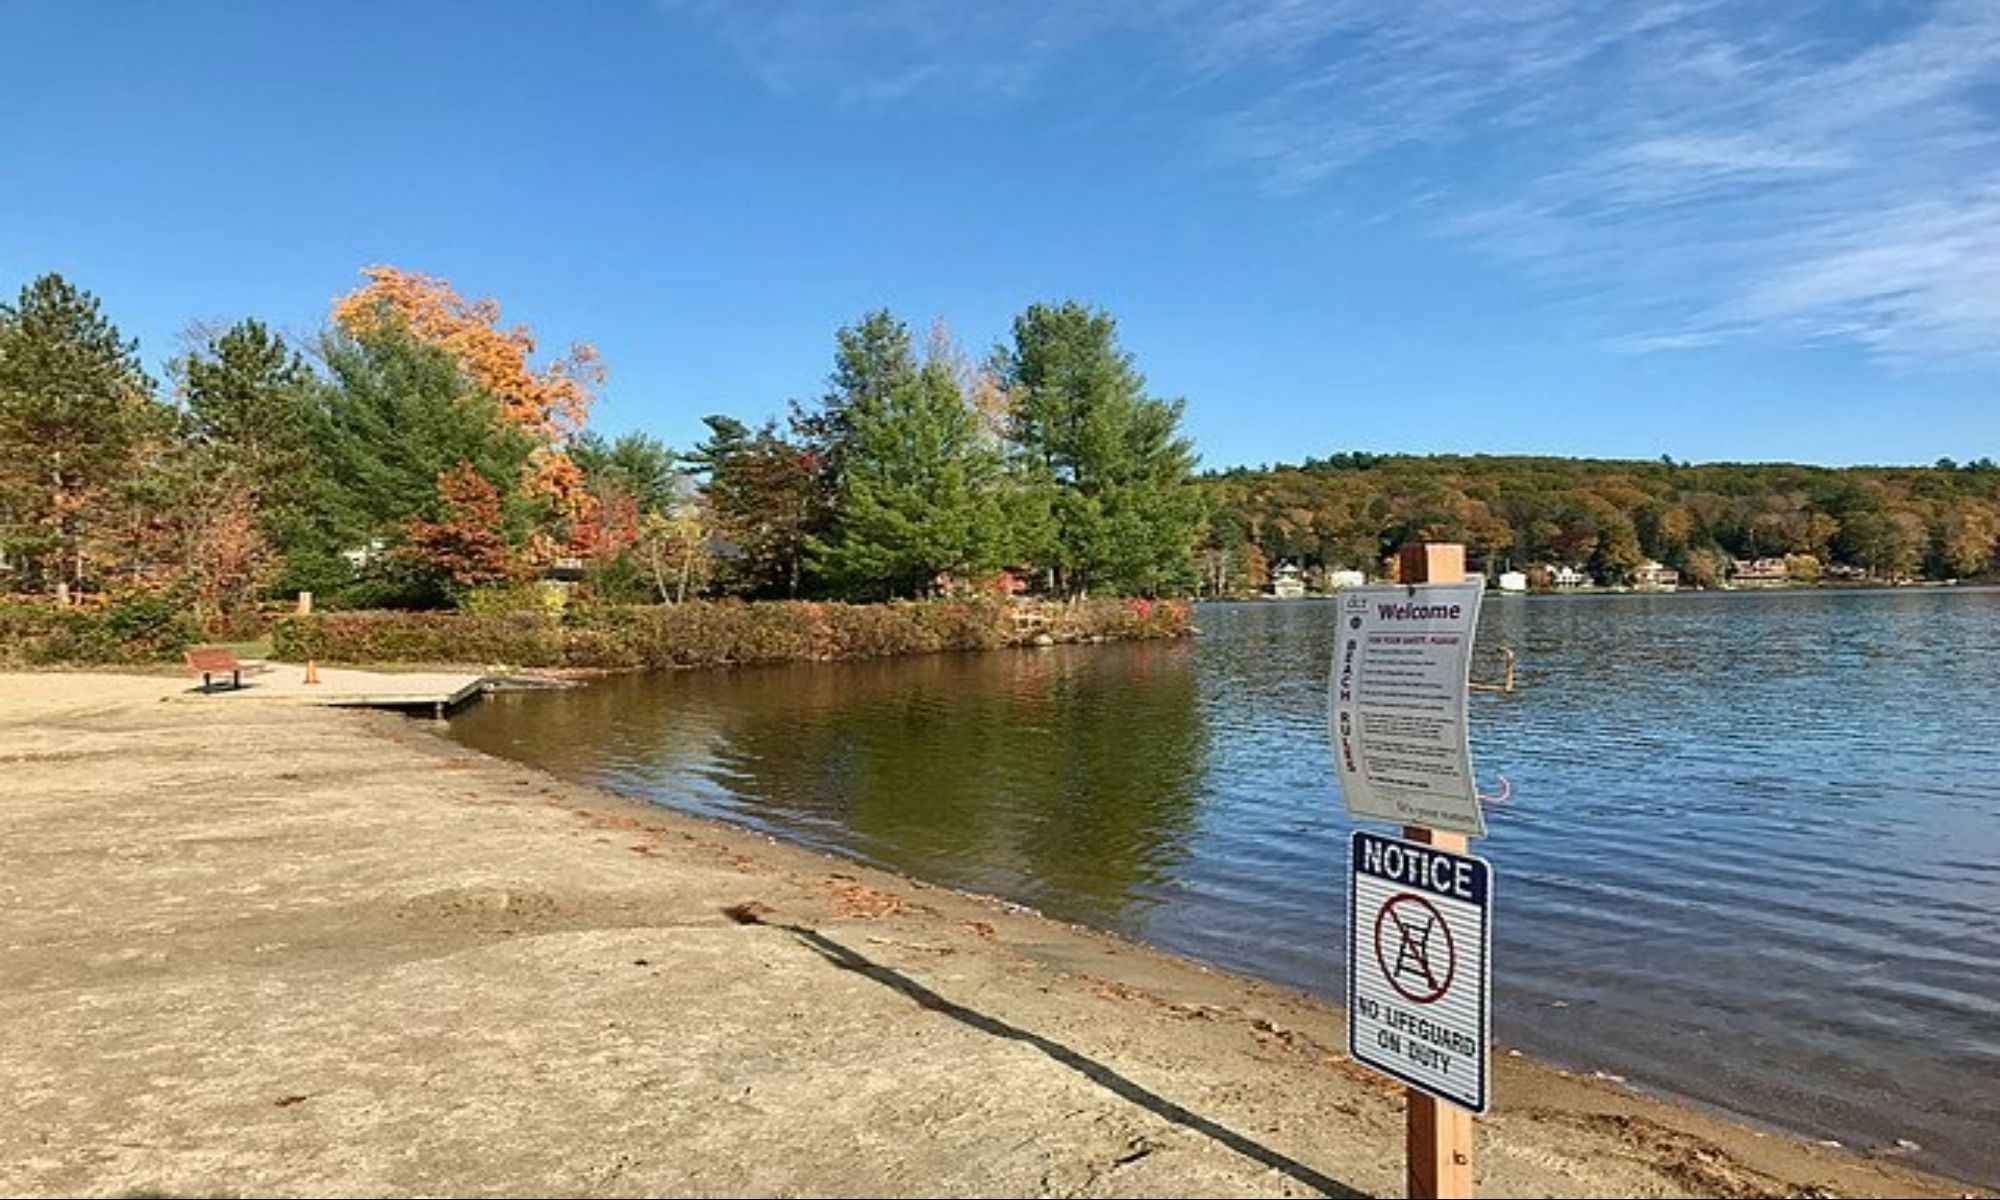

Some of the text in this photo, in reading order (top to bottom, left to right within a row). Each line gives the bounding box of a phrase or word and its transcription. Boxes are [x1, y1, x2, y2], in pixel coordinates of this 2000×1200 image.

[1378, 602, 1461, 621] Welcome
[1340, 638, 1357, 773] BEACH RULES
[1363, 838, 1473, 898] NOTICE
[1359, 996, 1476, 1058] NO LIFEGUARD
[1377, 1028, 1451, 1075] ON DUTY
